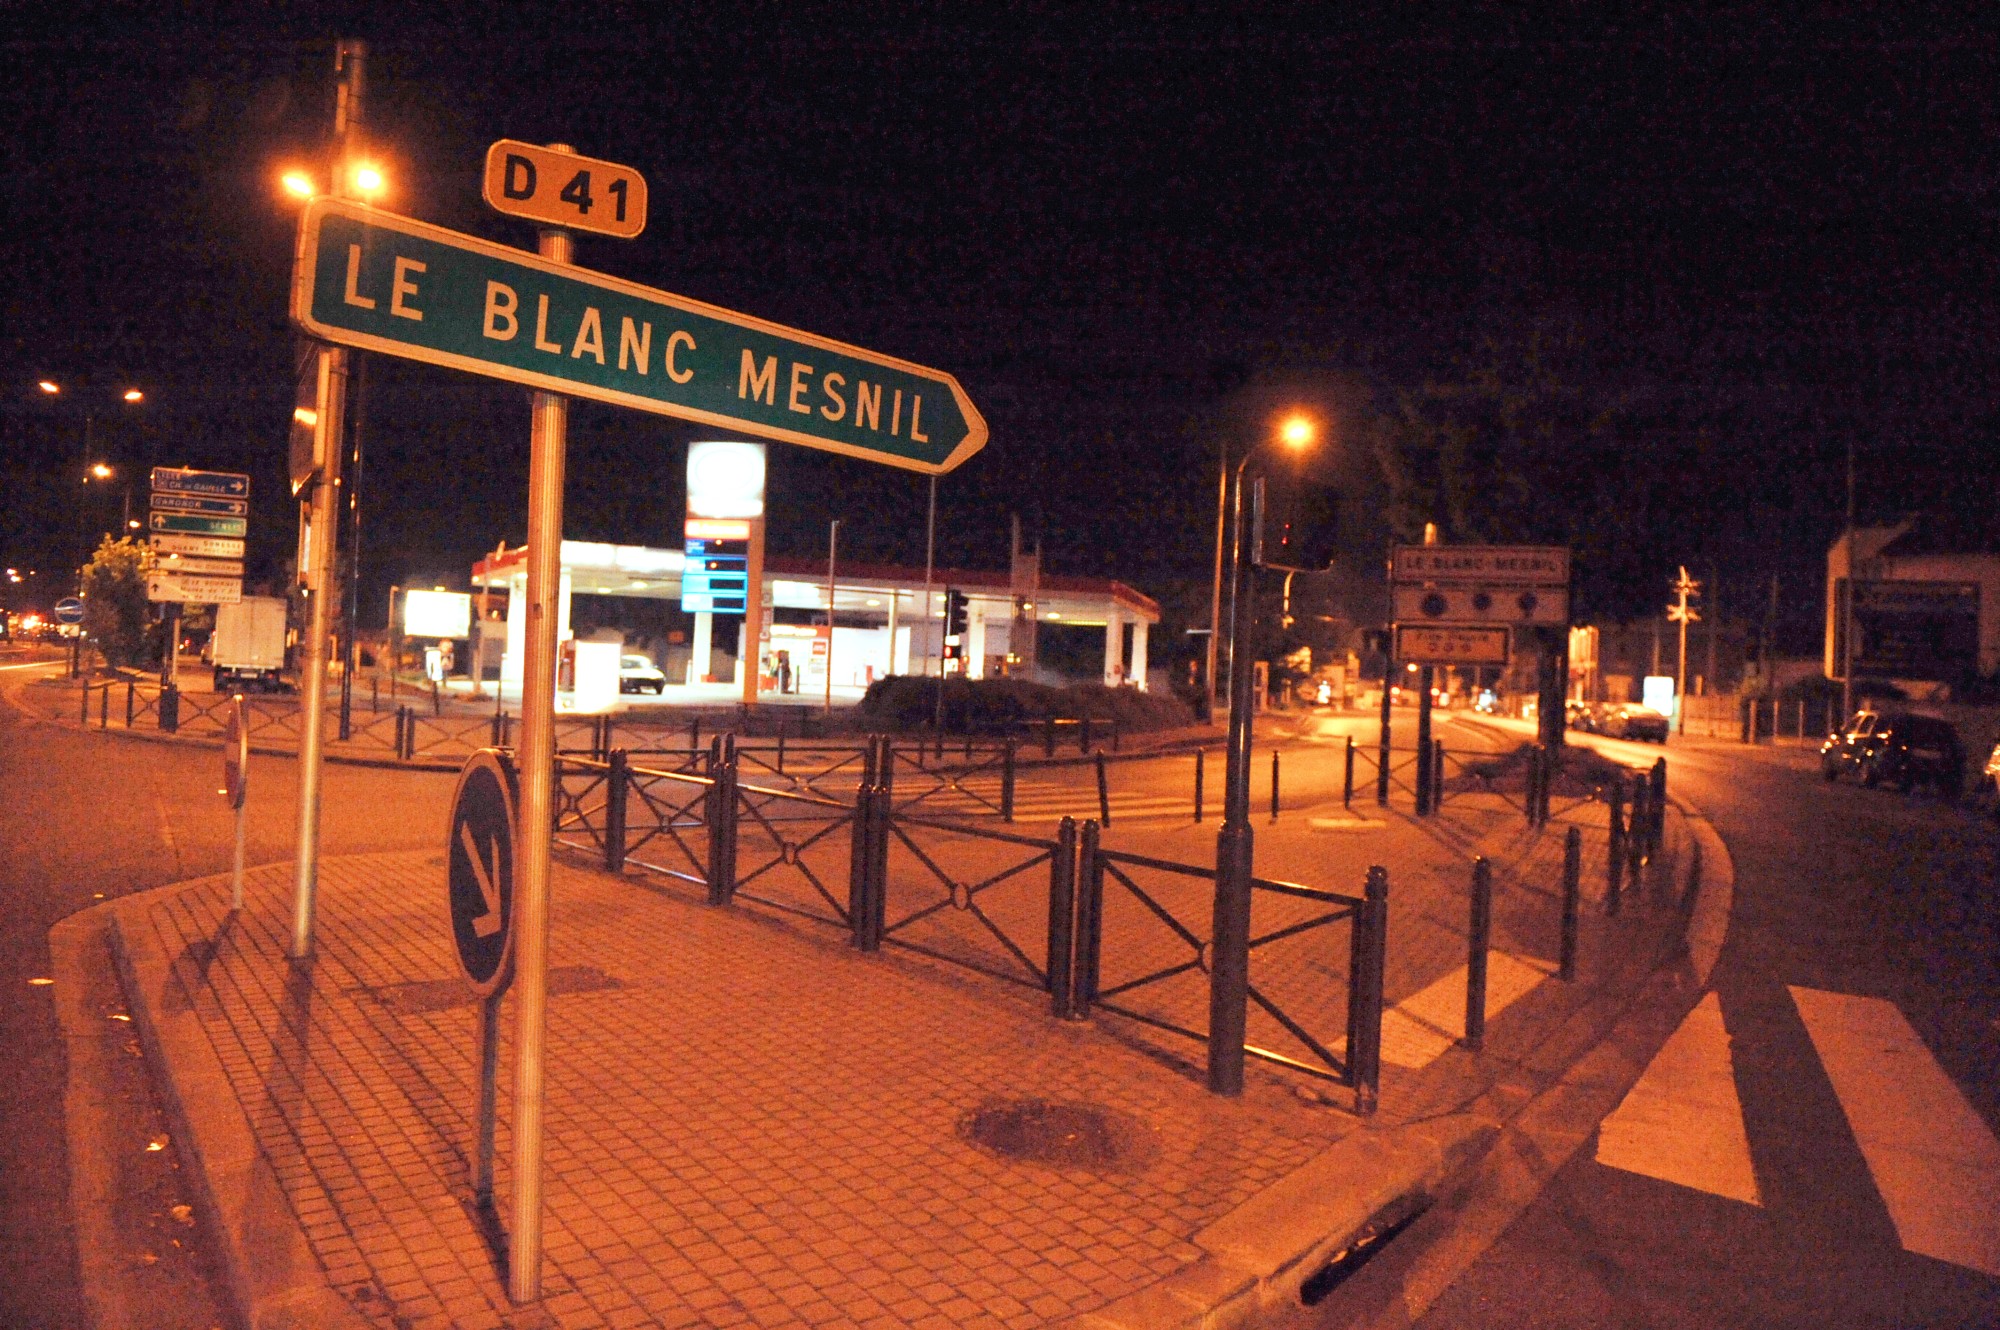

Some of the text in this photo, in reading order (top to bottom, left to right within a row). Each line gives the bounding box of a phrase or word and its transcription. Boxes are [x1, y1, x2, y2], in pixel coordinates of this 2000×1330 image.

[502, 152, 629, 223] D 41
[343, 243, 929, 444] LE BLANC MESNIL
